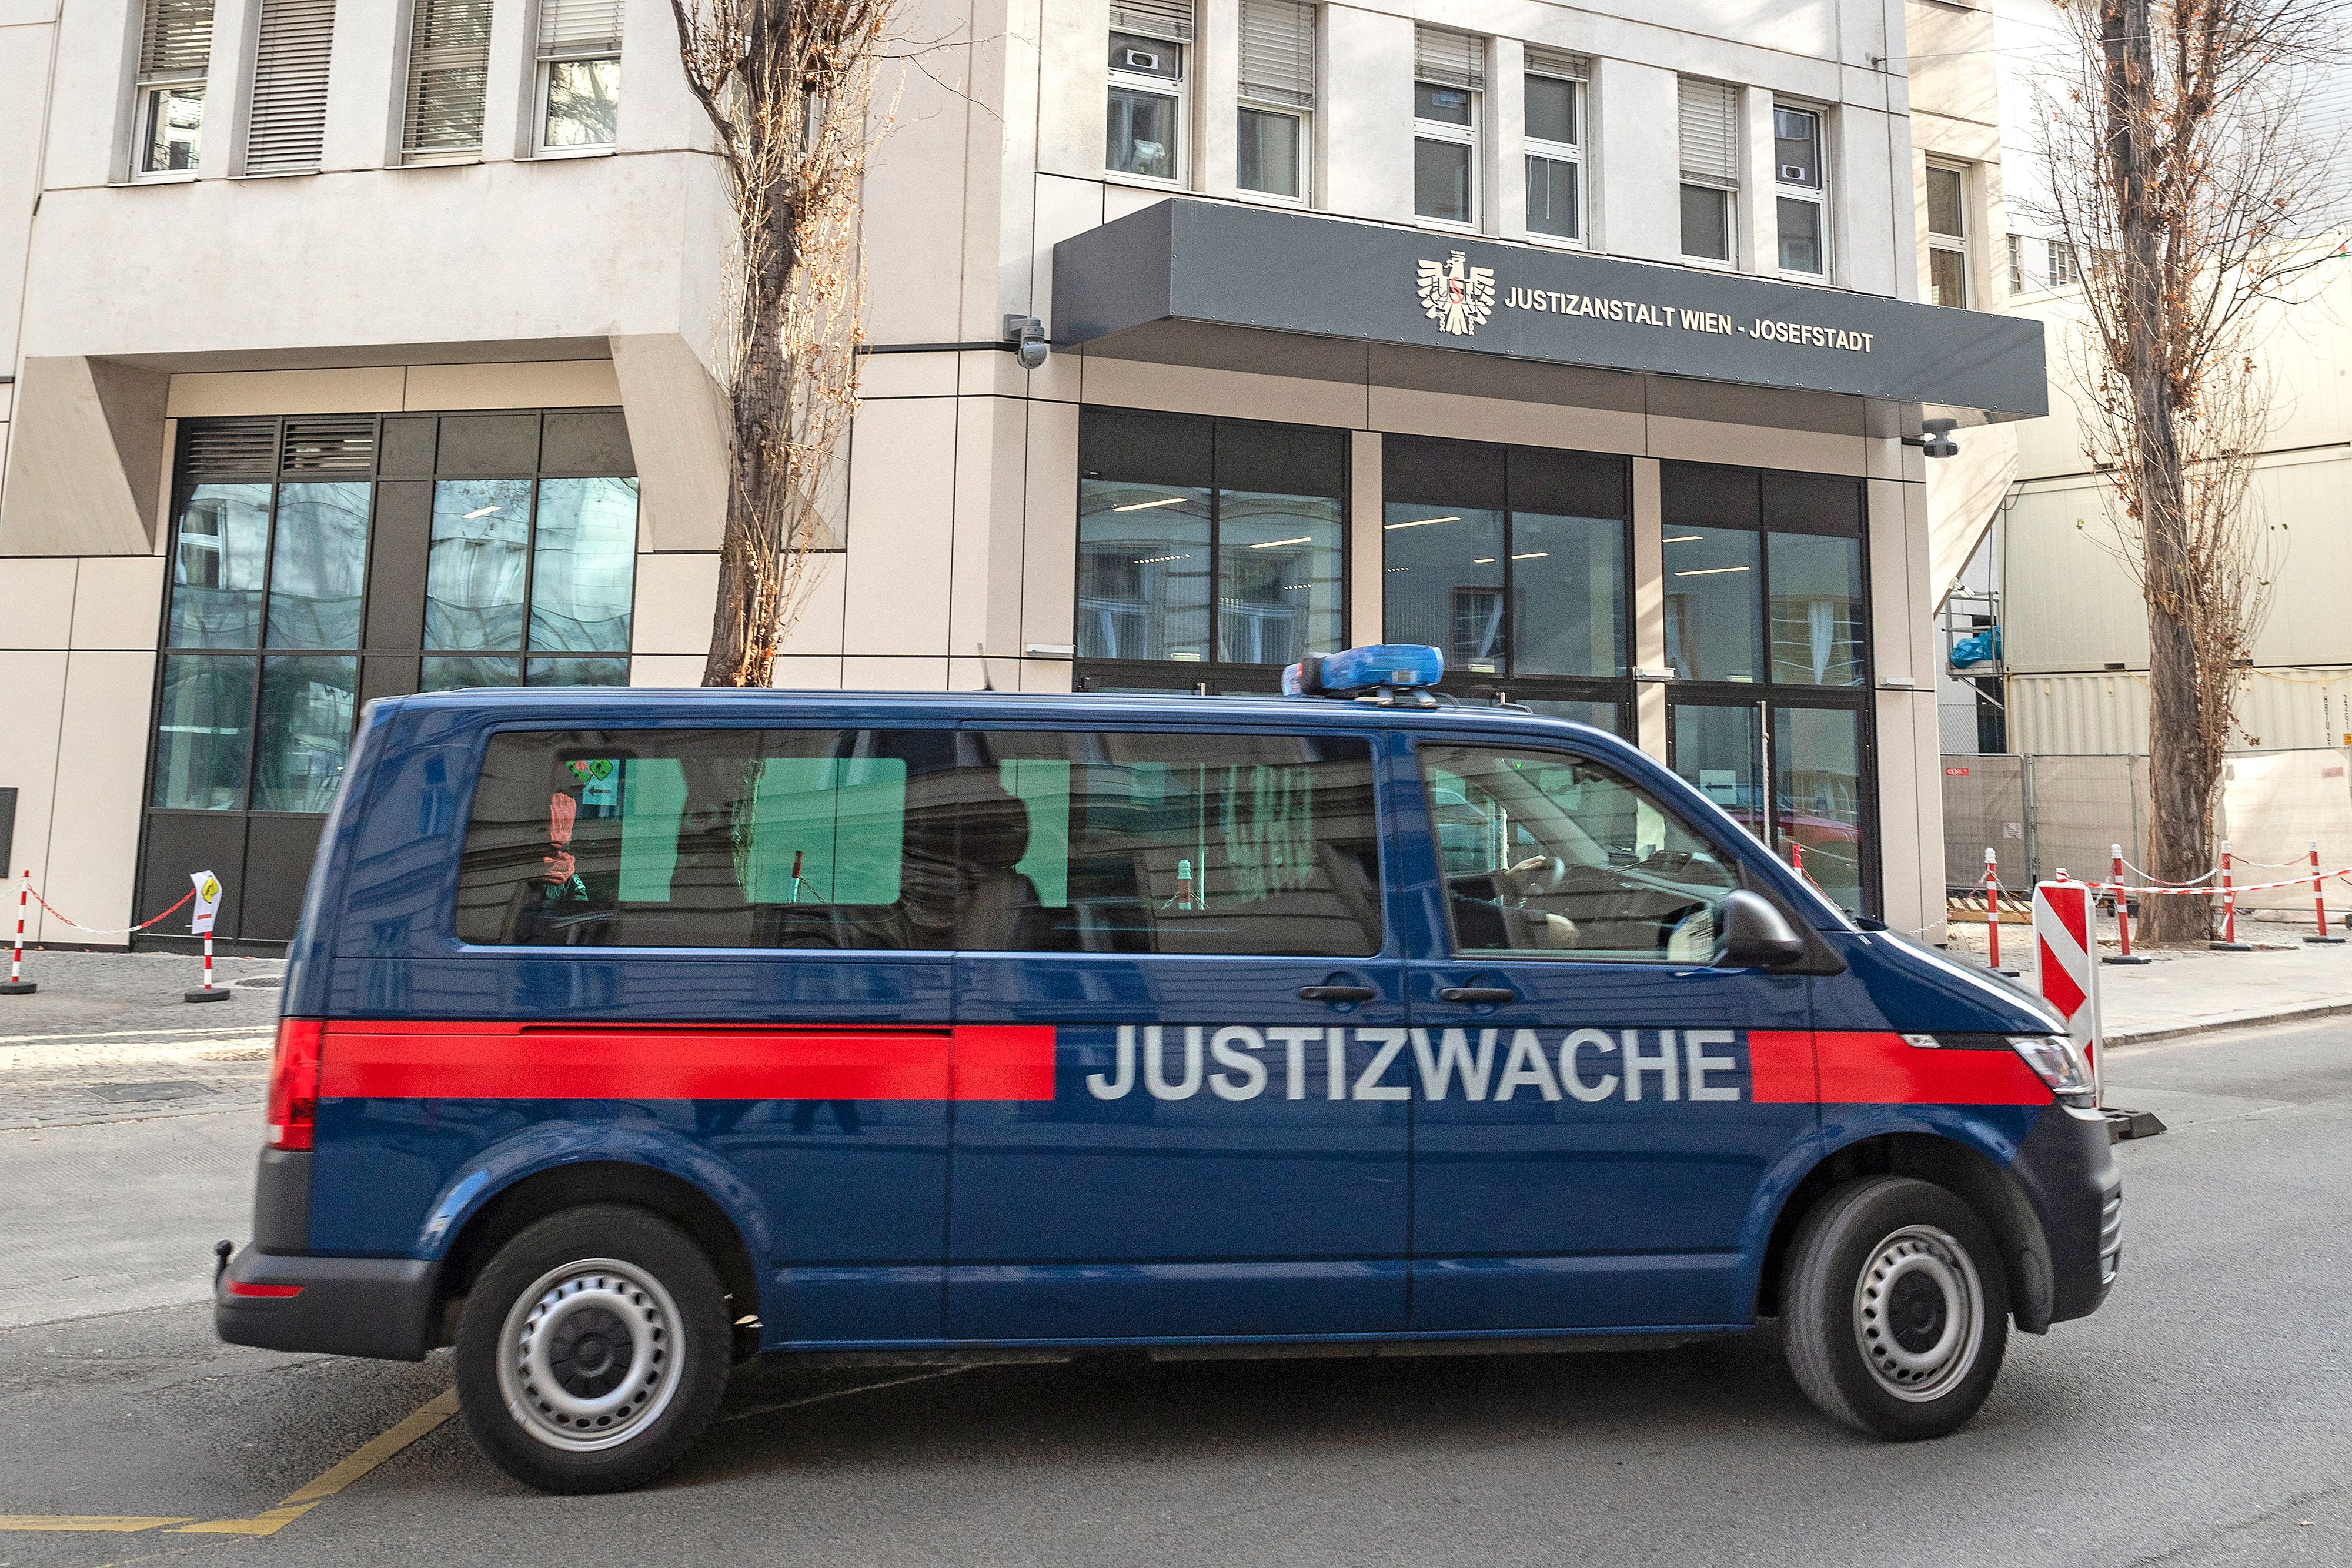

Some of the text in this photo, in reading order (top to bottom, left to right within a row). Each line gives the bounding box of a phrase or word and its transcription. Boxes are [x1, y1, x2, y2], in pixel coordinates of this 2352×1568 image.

[1504, 286, 1676, 327] JUSTIZANSTALT
[1679, 309, 1732, 335] WIEN
[1749, 319, 1874, 353] JOSEFSTADT
[1085, 1025, 1741, 1102] JUSTIZWACHE
